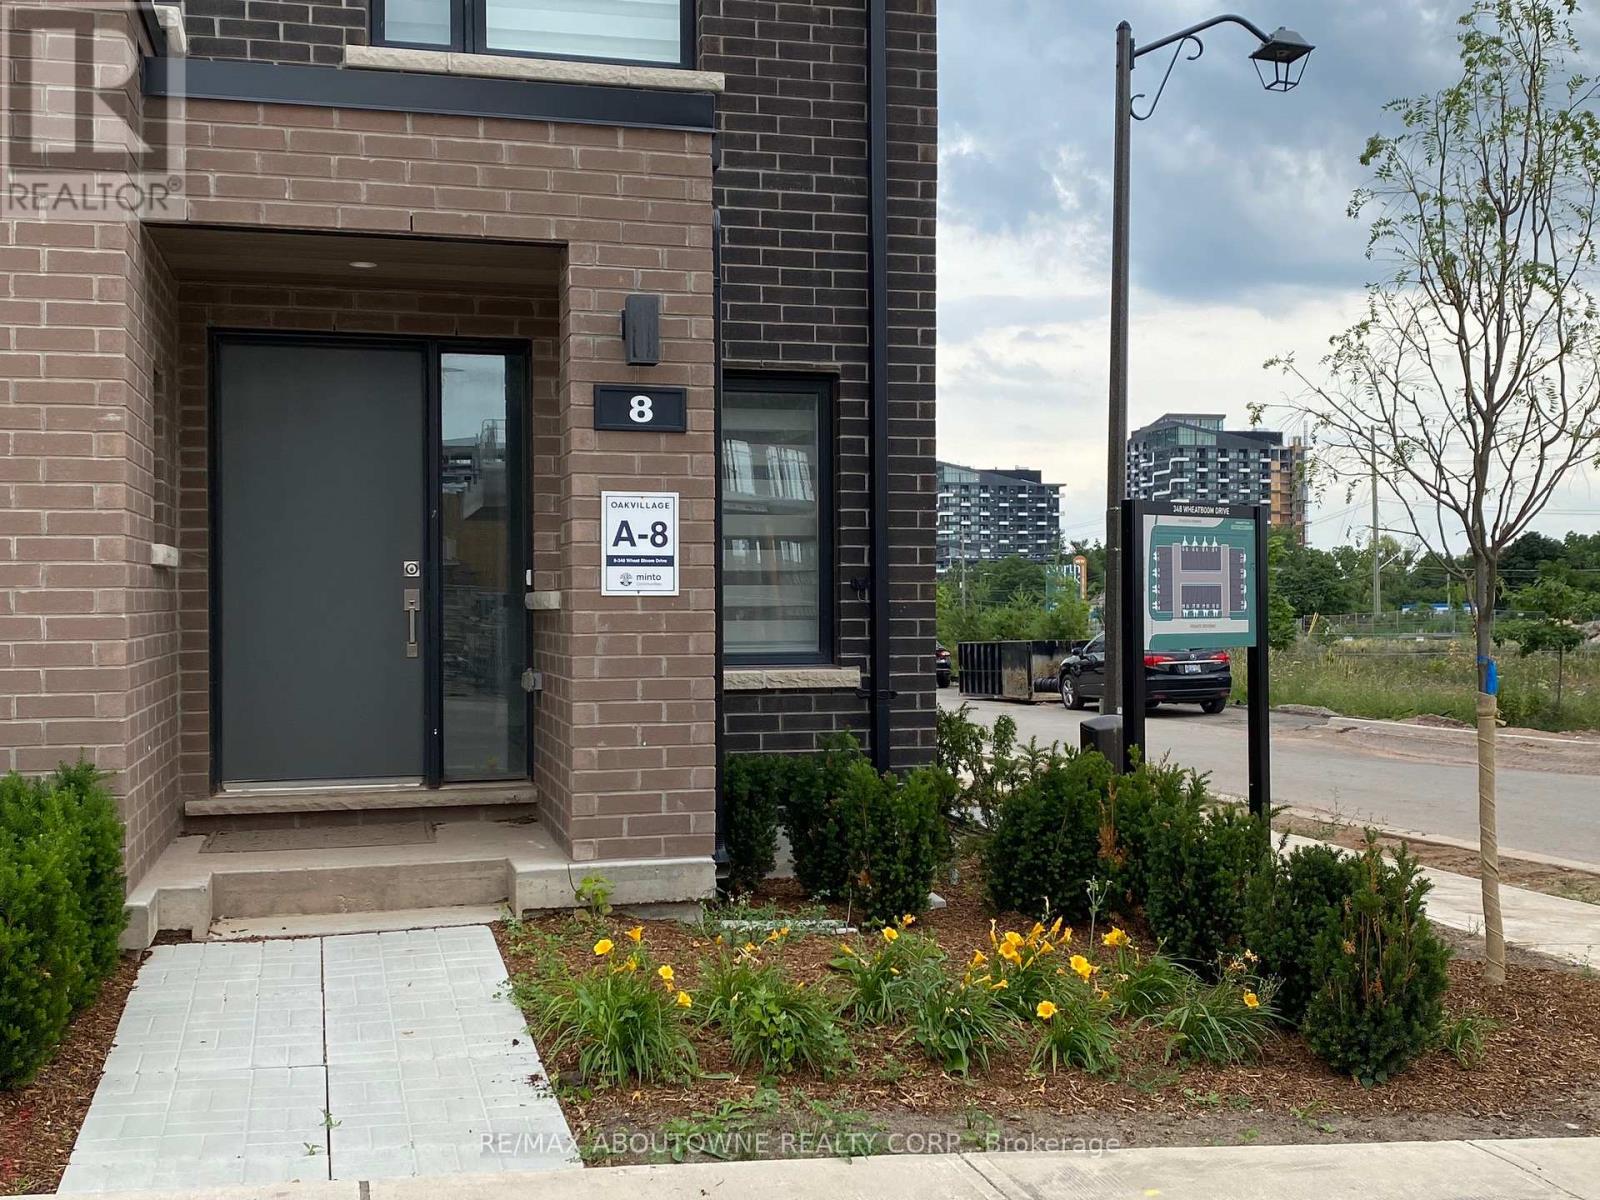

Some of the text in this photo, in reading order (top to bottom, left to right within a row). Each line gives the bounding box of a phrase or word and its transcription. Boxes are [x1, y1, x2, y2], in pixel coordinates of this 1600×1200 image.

[629, 395, 654, 423] 8
[610, 501, 671, 510] OAKVILLAGE
[612, 520, 668, 548] A-8
[636, 573, 662, 581] minto
